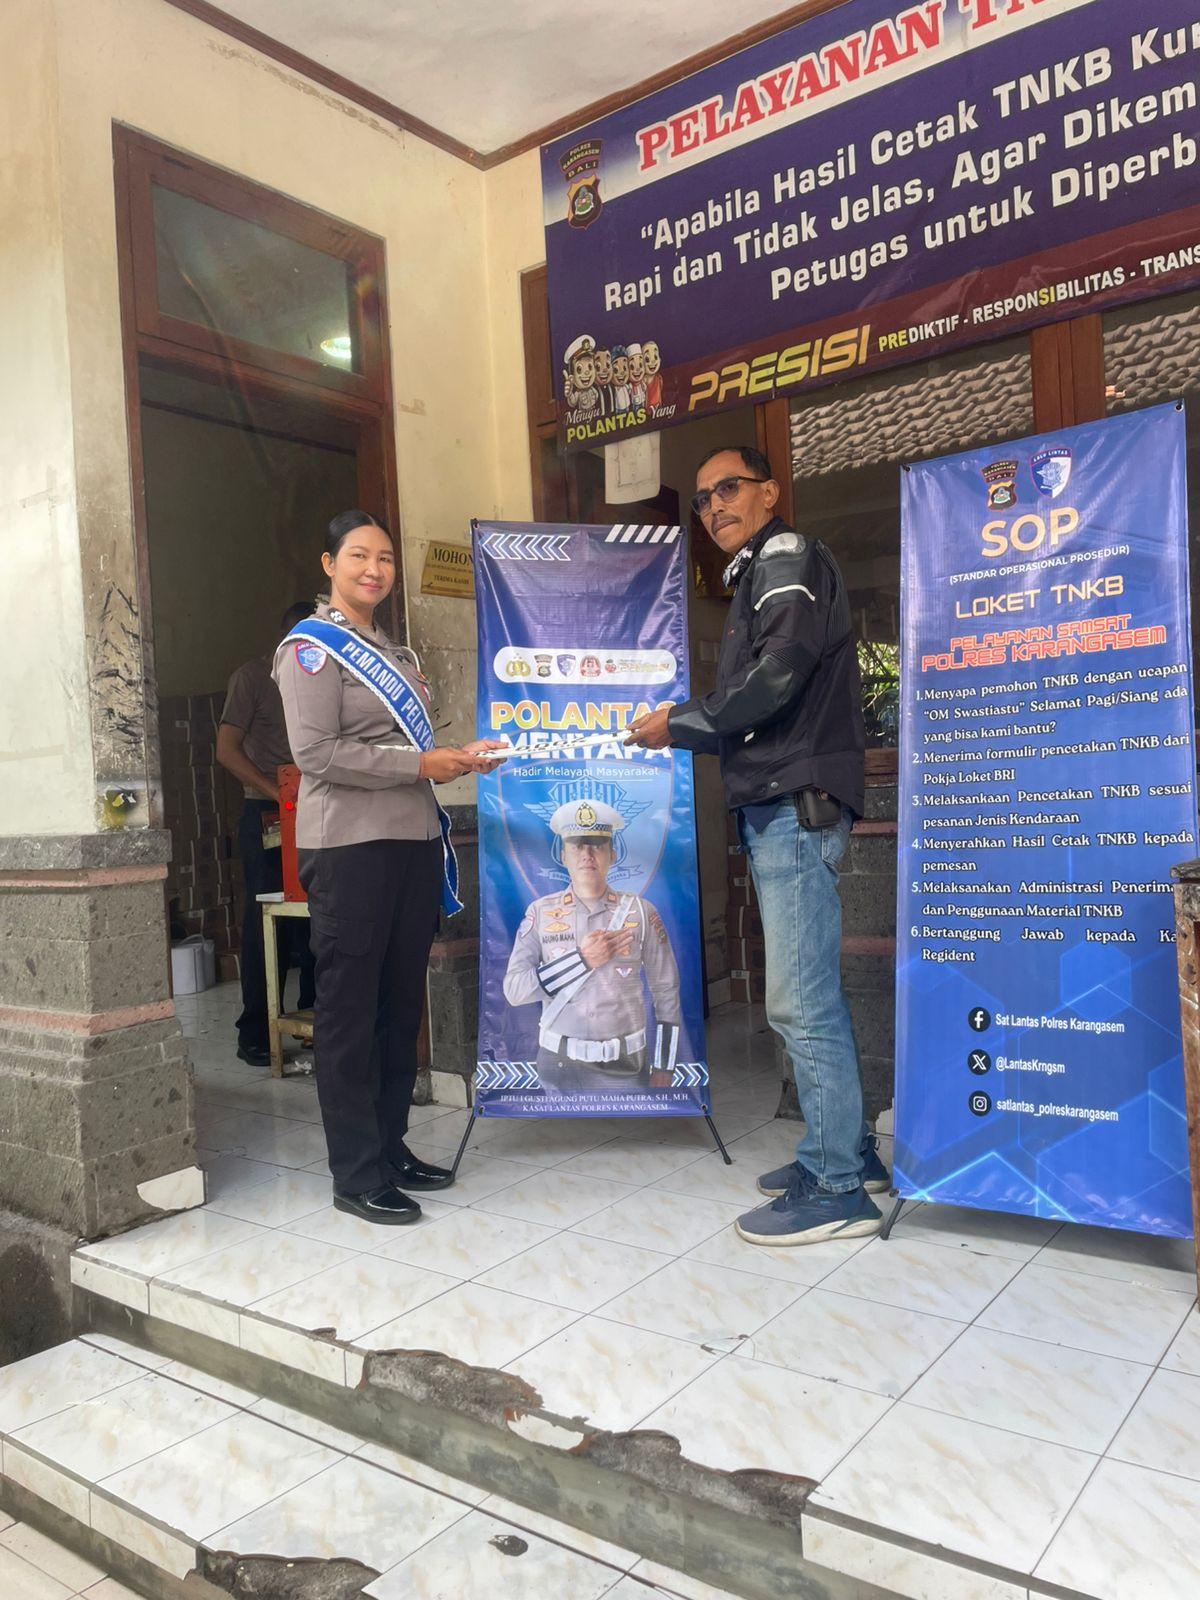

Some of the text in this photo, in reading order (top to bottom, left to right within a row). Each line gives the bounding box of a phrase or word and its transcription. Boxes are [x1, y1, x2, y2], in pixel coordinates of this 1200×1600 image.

[638, 1, 942, 171] PELAYANAN
[774, 144, 856, 203] Hasil
[871, 100, 979, 165] Cetak
[992, 47, 1112, 118] TNKB
[604, 81, 1197, 312] Rapi dan Tidak Jelas, Agar Dikem
[770, 132, 1197, 301] Petugas untuk Diperb
[878, 315, 960, 352] PREDIKTIF
[972, 266, 1126, 325] RESPONSIBILITAS
[688, 324, 871, 412] PRESISI
[566, 403, 677, 443] POLANTAS Yang
[980, 506, 1080, 558] SOP
[949, 545, 1131, 586] (STANDAR OPERASIONAL PROSEDUR)
[955, 575, 1124, 619] LOKET TNKB
[950, 614, 1132, 651] PELAYANAN SAMSAT
[921, 625, 1167, 672] POLRES KARANGASEM
[341, 641, 406, 702] PEMANDU
[981, 680, 1037, 697] pemohon
[1042, 674, 1079, 689] TNKB
[1083, 669, 1133, 686] dengan
[1138, 663, 1187, 681] ucapan
[1029, 699, 1081, 712] Selamat
[1087, 690, 1159, 709] Pagi/Siang
[1164, 685, 1188, 699] ada
[924, 721, 1056, 744] yang bisa kami bantu?
[986, 746, 1037, 760] formulir
[1041, 741, 1116, 759] pencetakan
[1120, 736, 1160, 750] TNKB
[1163, 733, 1190, 747] dari
[513, 766, 658, 779] Hadir Melayani Masyarakat
[923, 768, 1016, 786] Pokja Loket BRI
[1017, 788, 1093, 802] Pencetakan
[1101, 784, 1140, 798] TNKB
[1149, 781, 1192, 796] sesuai
[923, 811, 1080, 830] pesanan Jenis Kendaraan
[1012, 834, 1045, 848] Hasil
[1052, 833, 1090, 847] Cetak
[1097, 832, 1137, 846] TNKB
[1144, 831, 1194, 846] kepada
[922, 860, 977, 874] pemesan
[1018, 881, 1103, 894] Administrasi
[1111, 880, 1174, 893] Penerim
[922, 904, 1123, 918] dan Penggunaan Material TNKB
[1021, 928, 1064, 941] Jawab
[1086, 929, 1136, 943] kepada
[922, 949, 976, 962] Regident
[995, 1014, 1125, 1034] Sat Lantas Polres Karangasem
[995, 1056, 1065, 1075] @LantasKrngsm
[996, 1099, 1119, 1122] satlantas_polreskarangasem
